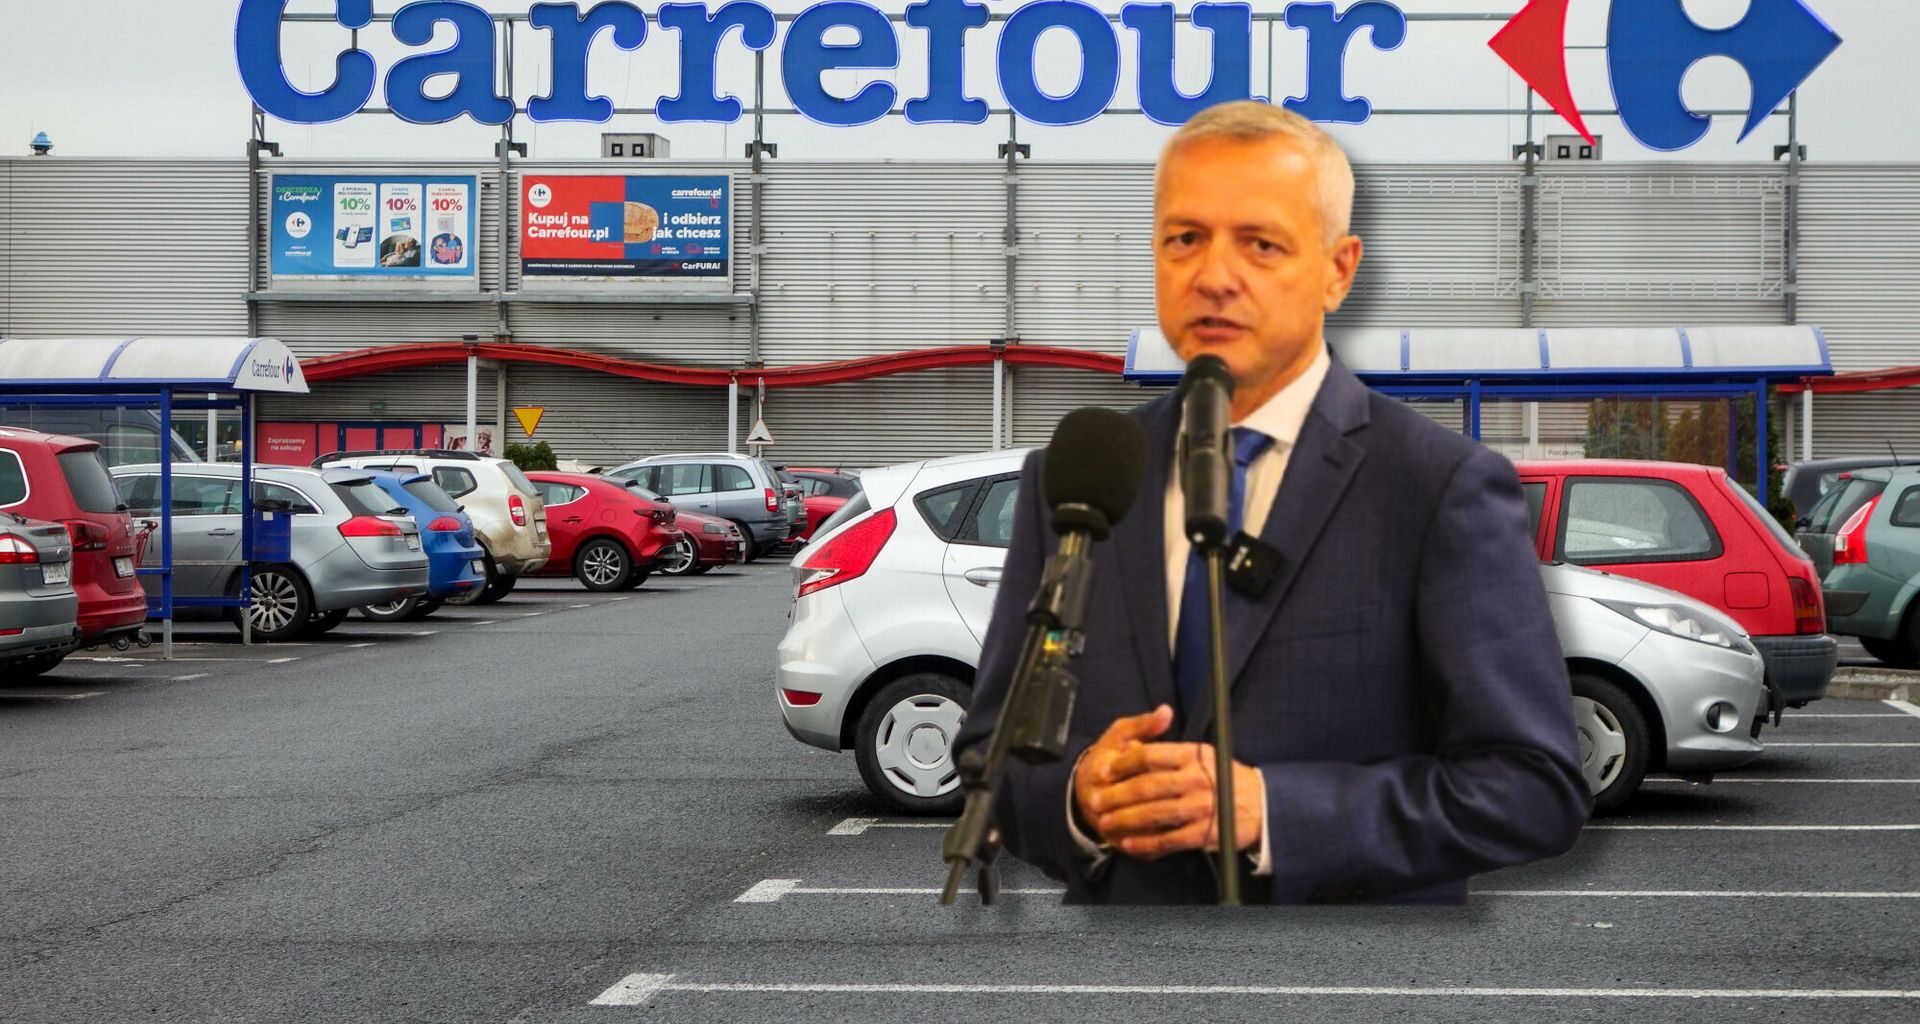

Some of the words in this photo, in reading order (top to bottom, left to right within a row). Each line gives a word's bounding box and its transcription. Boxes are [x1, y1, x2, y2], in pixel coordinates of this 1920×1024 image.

[233, 0, 1407, 126] Carrefour
[284, 192, 320, 203] Carrefour!
[671, 188, 722, 197] carrefour.pl
[340, 197, 371, 210] 10%
[386, 198, 417, 211] 10%
[432, 198, 463, 211] 10%
[528, 212, 568, 226] Kupuj
[571, 215, 589, 224] na
[663, 212, 668, 225] i
[671, 212, 721, 225] odbierz
[528, 226, 609, 241] Carrefour.pl
[652, 226, 673, 241] jak
[676, 226, 721, 239] chcesz
[682, 262, 721, 270] CarFURA!
[251, 359, 280, 378] Carrefour
[267, 437, 306, 445] Zapraszamy
